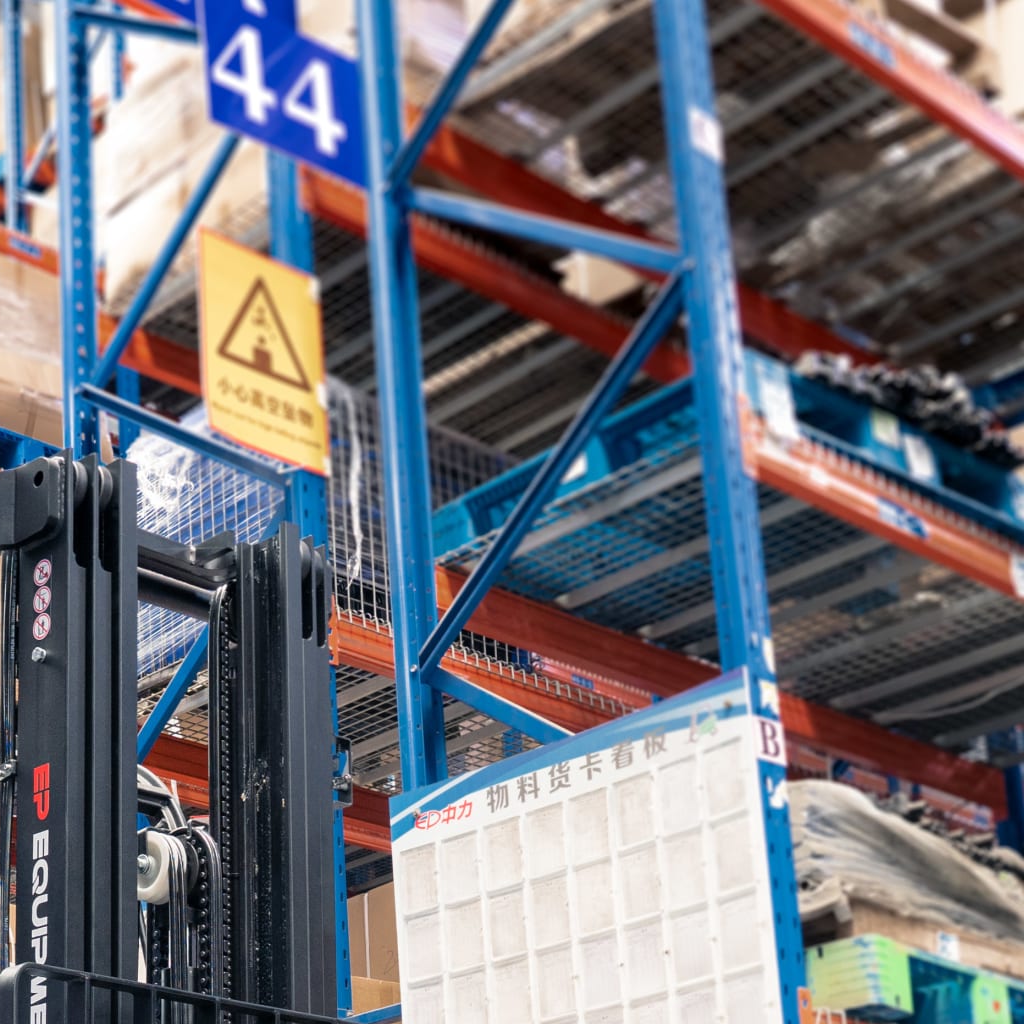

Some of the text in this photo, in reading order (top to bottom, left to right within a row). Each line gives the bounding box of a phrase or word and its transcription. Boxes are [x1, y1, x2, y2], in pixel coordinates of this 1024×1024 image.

[212, 24, 348, 158] 44
[485, 726, 667, 814] 物料货卡看板
[760, 719, 780, 758] B
[33, 762, 50, 820] EP
